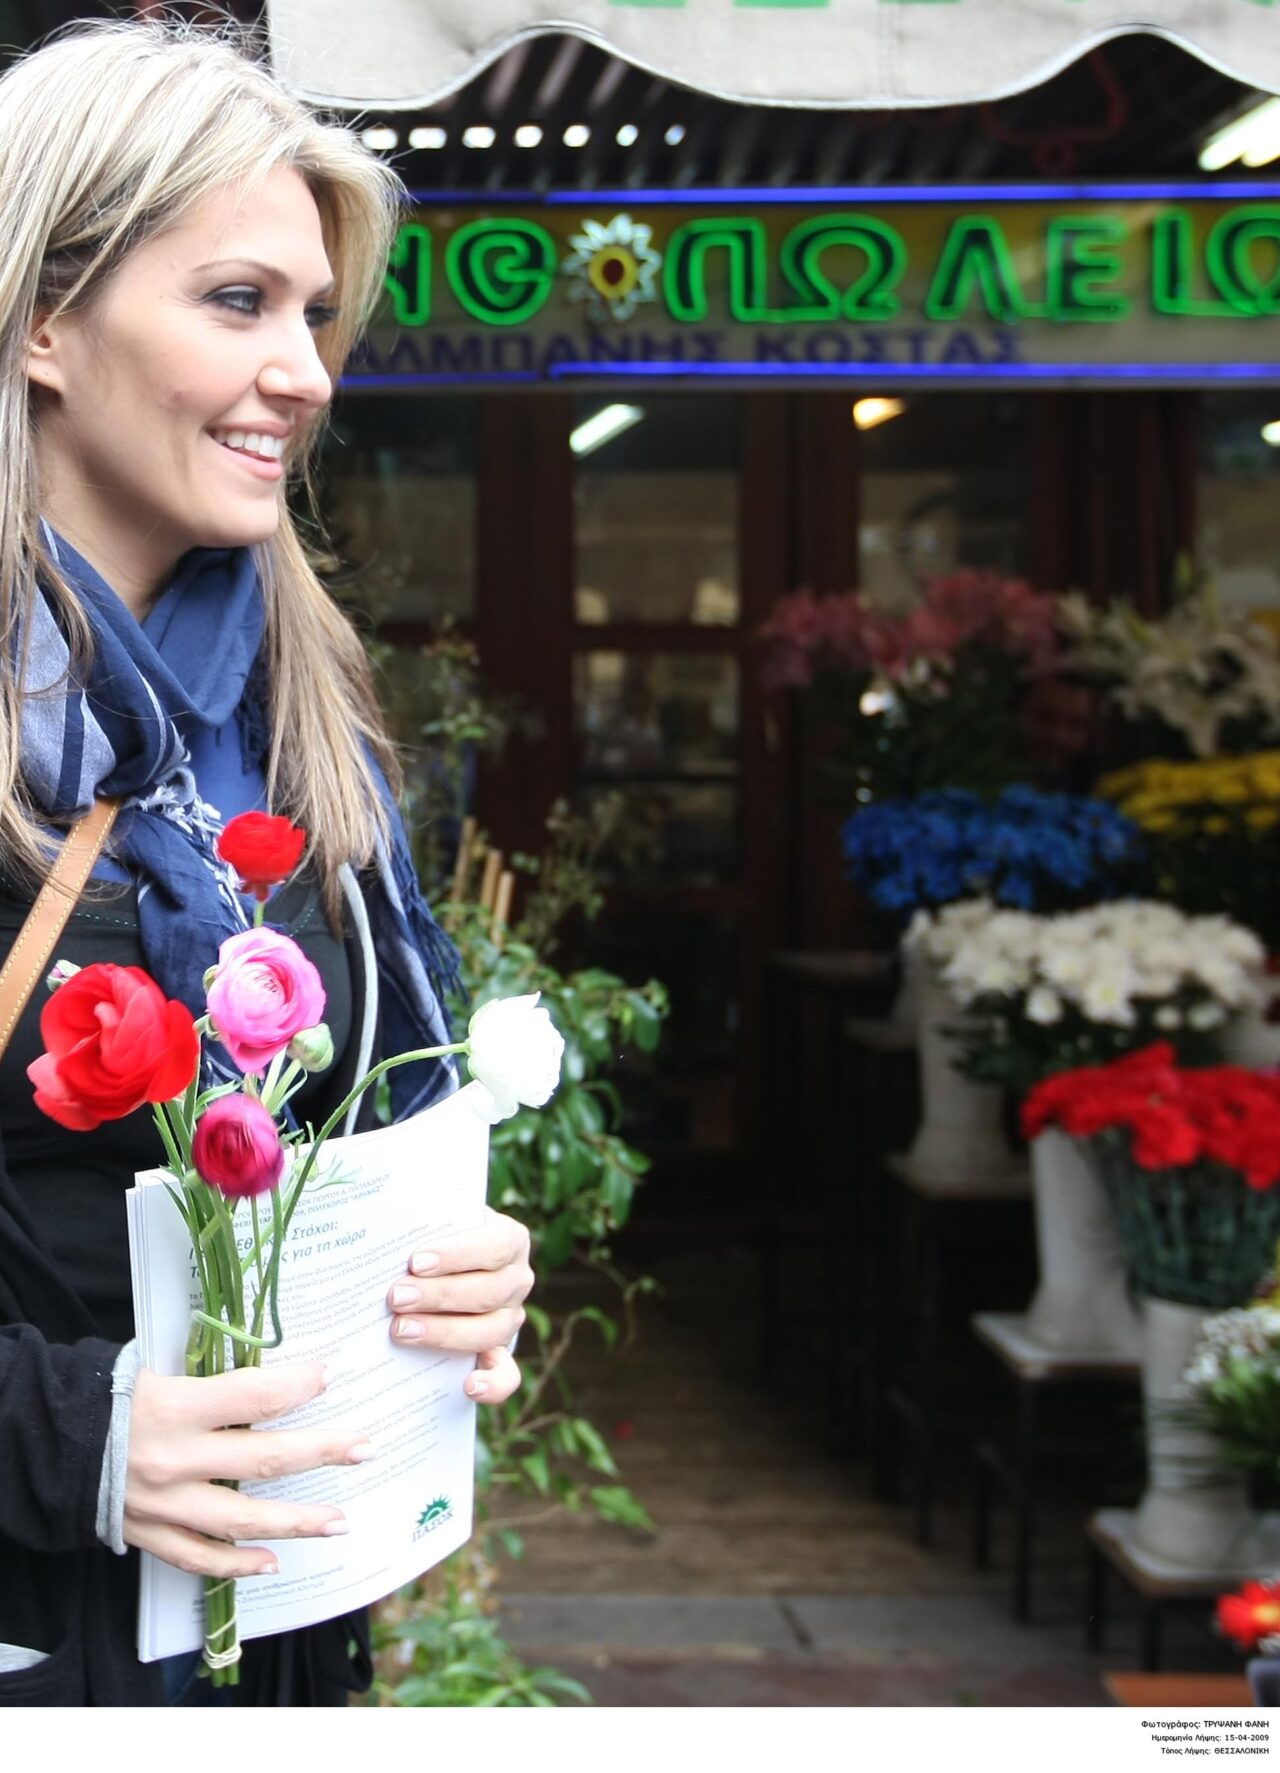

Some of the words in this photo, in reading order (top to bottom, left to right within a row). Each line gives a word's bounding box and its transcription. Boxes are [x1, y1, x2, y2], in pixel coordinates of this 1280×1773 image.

[291, 1219, 339, 1241] Στόχοι:
[292, 1247, 312, 1263] για
[316, 1240, 331, 1253] τη
[333, 1228, 367, 1248] χώρα
